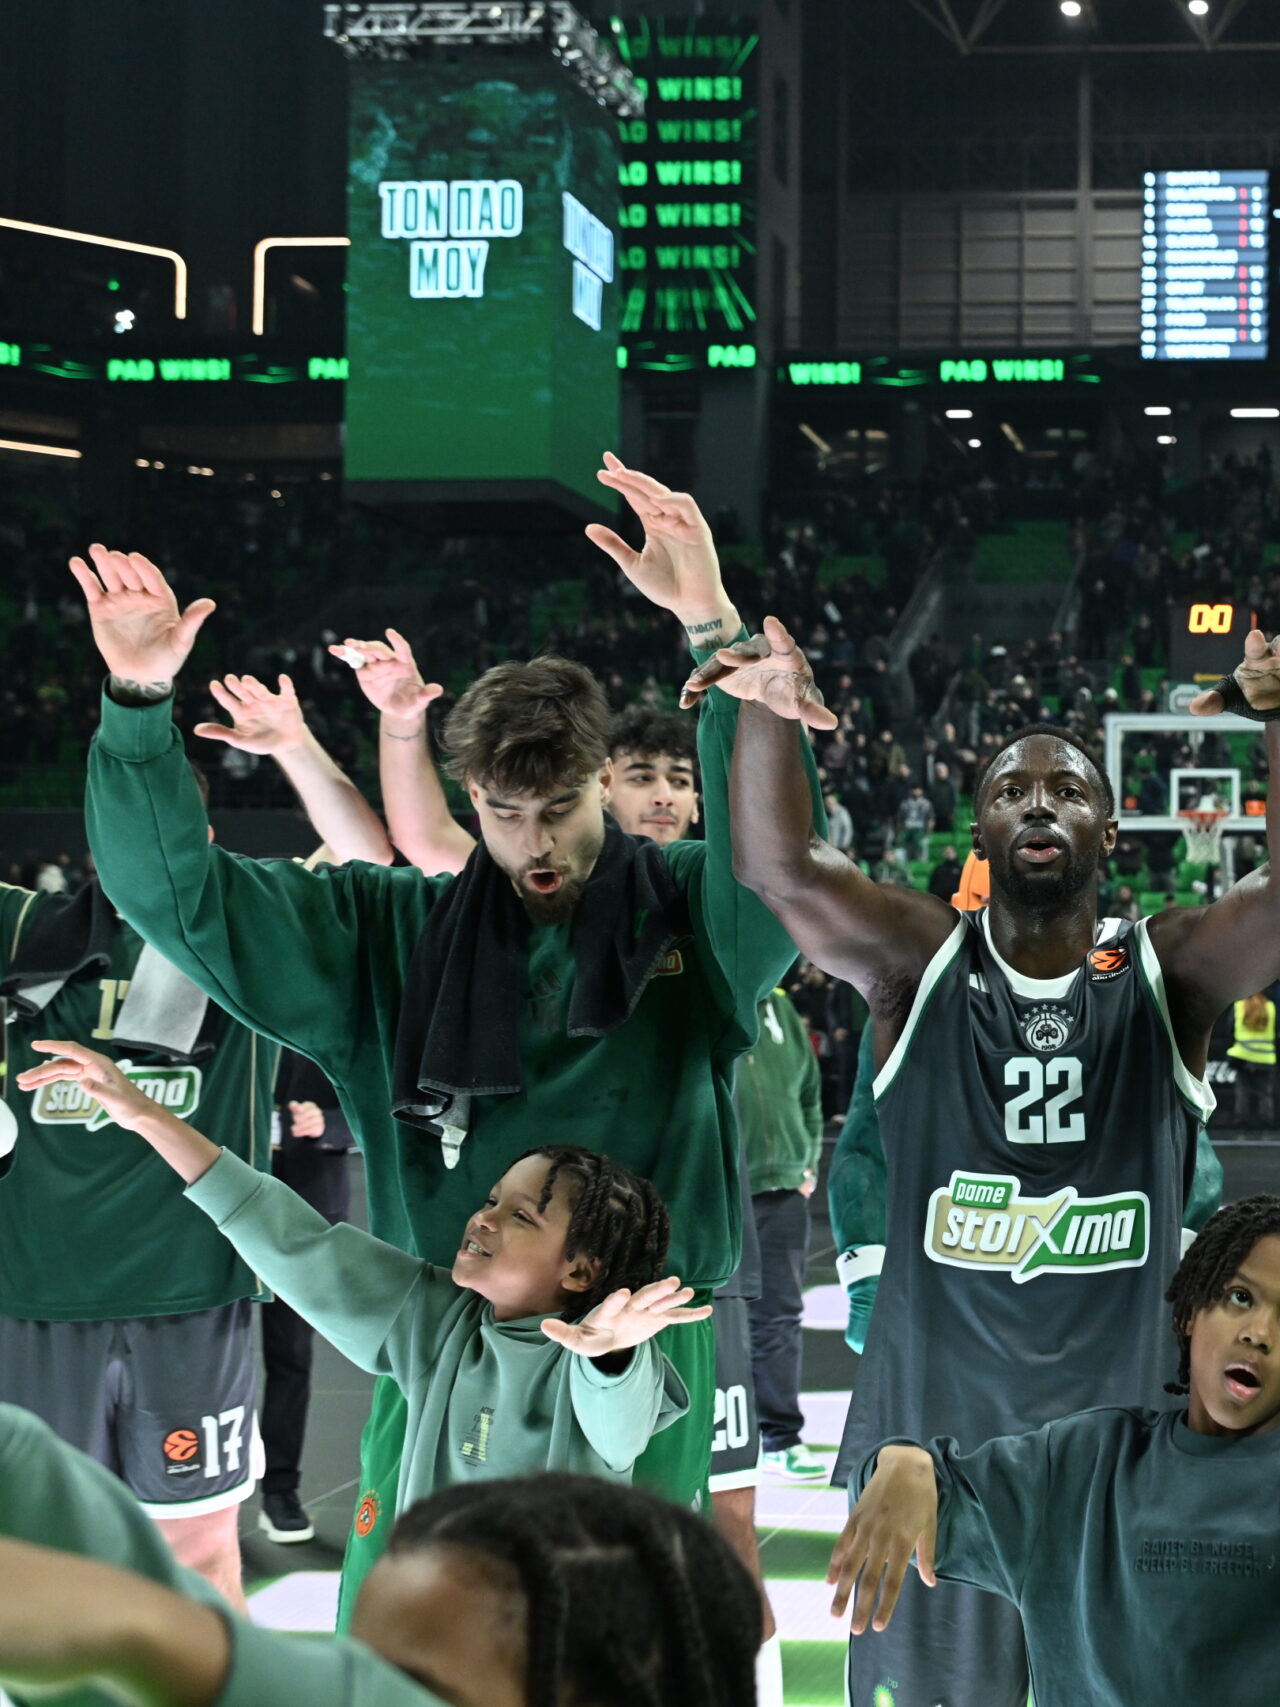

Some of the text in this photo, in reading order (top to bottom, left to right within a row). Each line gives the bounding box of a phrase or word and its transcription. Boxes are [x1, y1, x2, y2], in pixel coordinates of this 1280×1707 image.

[656, 77, 742, 101] WINS!
[656, 120, 742, 143] WINS!
[655, 161, 742, 185] WINS!
[453, 183, 519, 234] ΠΑΟ
[655, 203, 742, 227] WINS!
[107, 358, 231, 381] PAO WINS!
[708, 344, 861, 385] PAO WINS!
[940, 359, 1065, 383] PAO WINS!
[1004, 1056, 1086, 1144] 22
[956, 1182, 1006, 1204] pame
[711, 1384, 750, 1454] 20
[201, 1405, 245, 1476] 17
